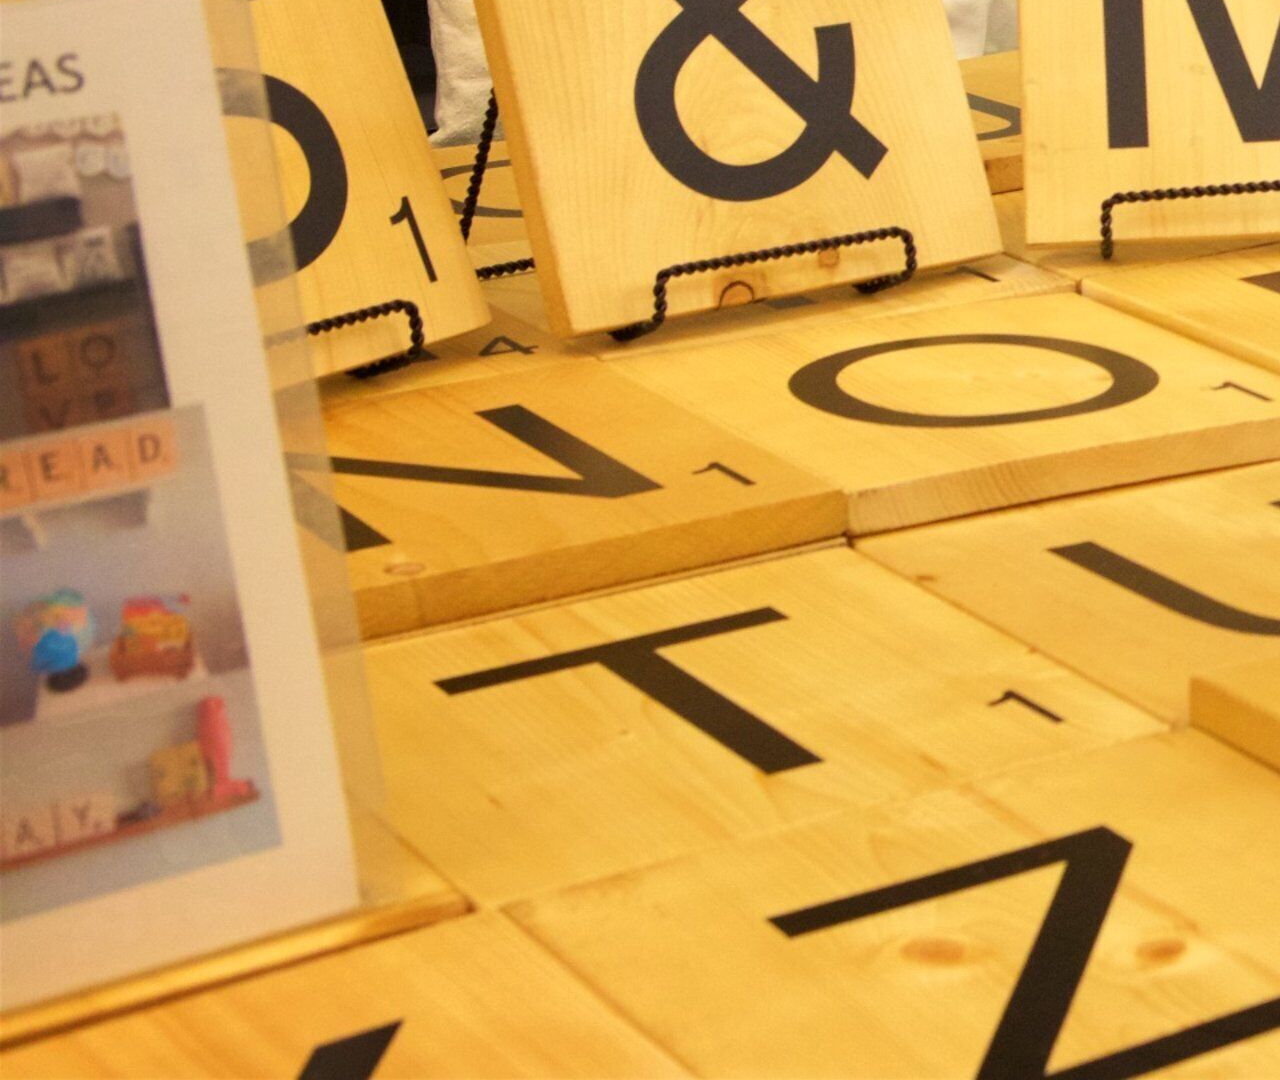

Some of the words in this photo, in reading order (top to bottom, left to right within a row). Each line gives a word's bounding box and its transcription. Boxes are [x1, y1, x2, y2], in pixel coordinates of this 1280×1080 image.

[388, 195, 438, 283] 1
[787, 333, 1160, 428] O
[432, 606, 825, 776] T
